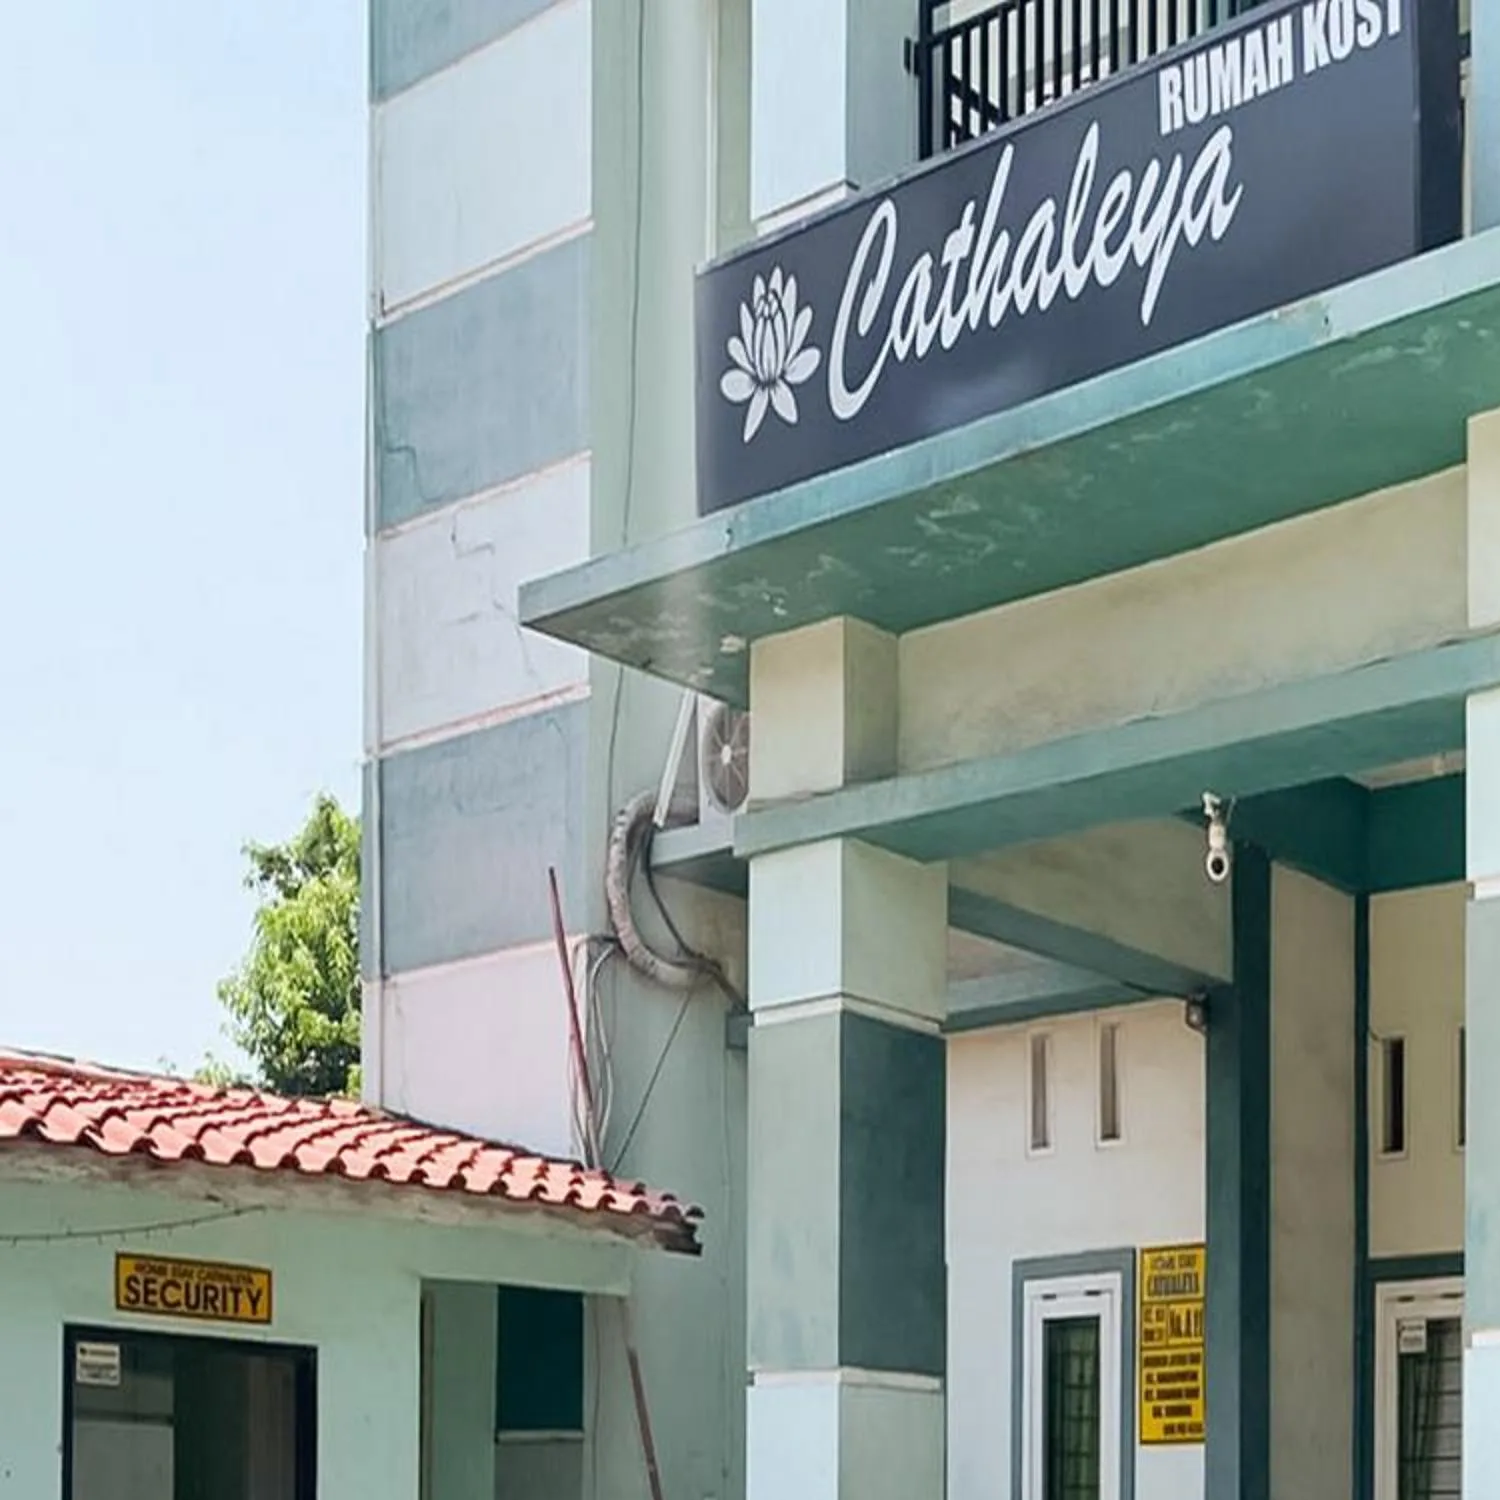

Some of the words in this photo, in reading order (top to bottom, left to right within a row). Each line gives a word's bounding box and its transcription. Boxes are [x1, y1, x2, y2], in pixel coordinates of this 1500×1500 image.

[1159, 13, 1294, 135] RUMAH
[828, 120, 1243, 420] Cathaleya
[124, 1275, 262, 1317] SECURITY
